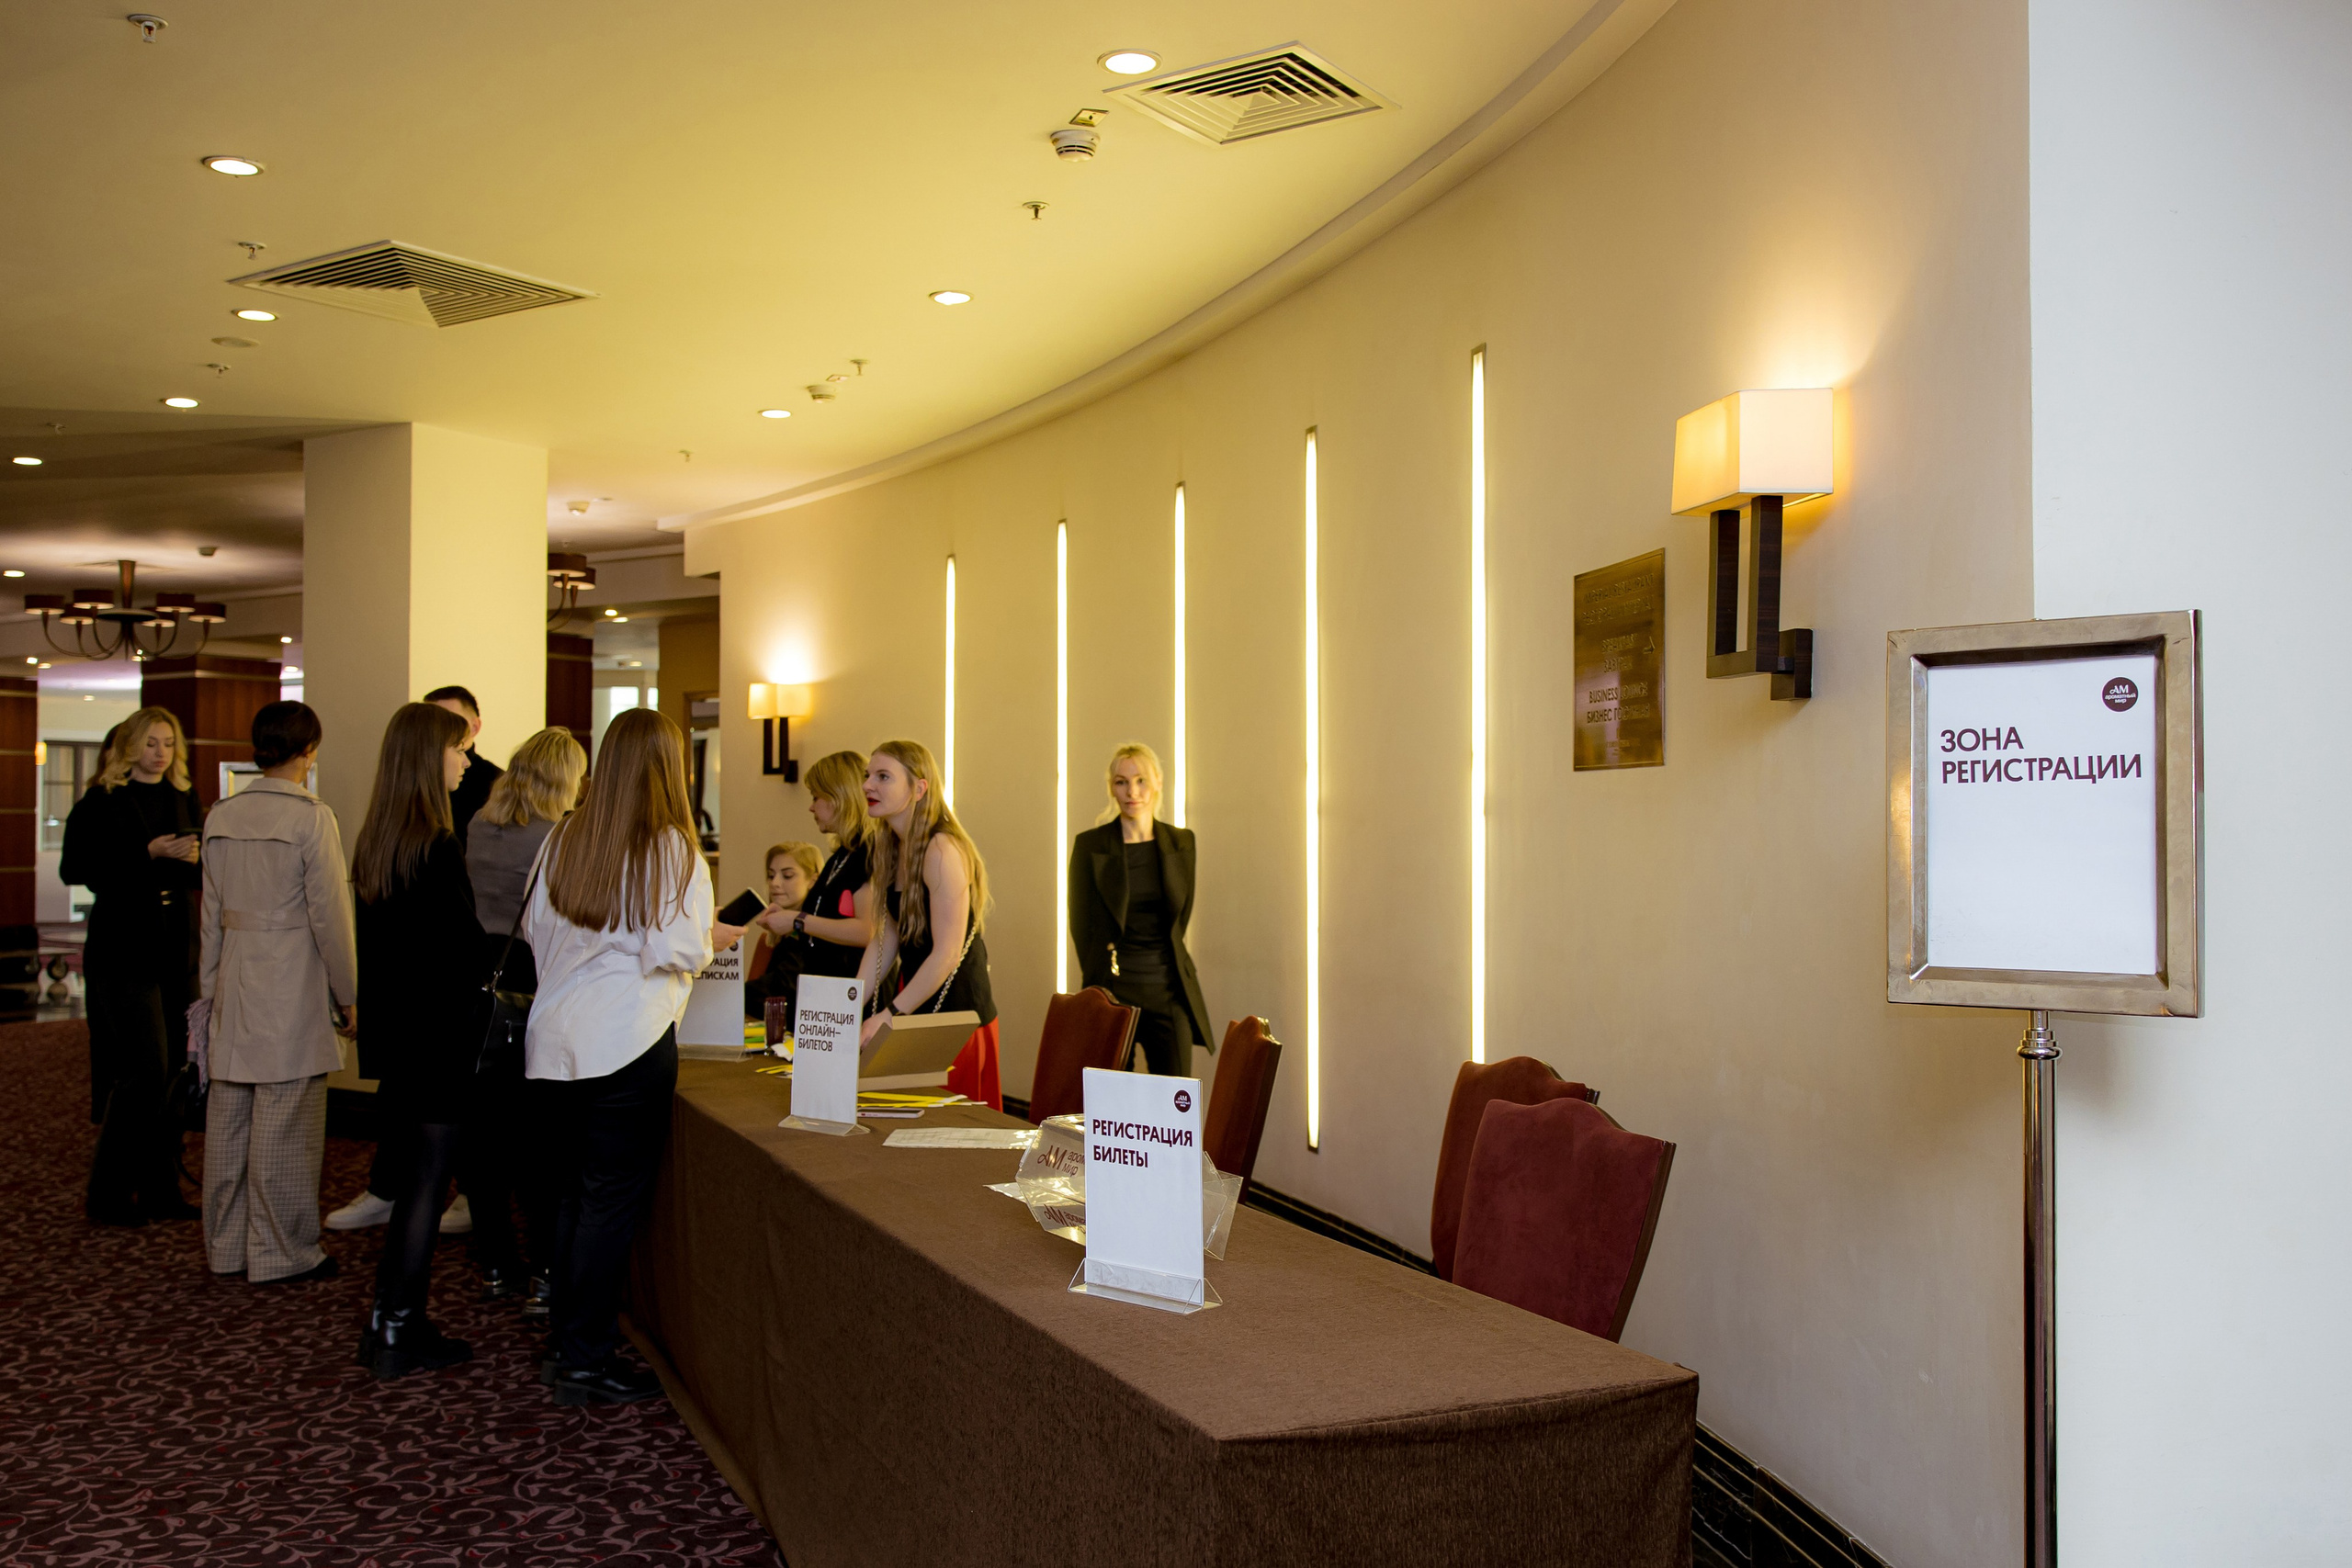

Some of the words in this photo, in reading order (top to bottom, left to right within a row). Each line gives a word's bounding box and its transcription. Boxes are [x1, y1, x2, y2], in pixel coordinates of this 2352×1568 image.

[1589, 687, 1618, 704] BUSINESS
[1587, 707, 1612, 724] БИЗНЕС
[1939, 726, 2025, 753] ЗОНА
[1940, 753, 2143, 784] РЕГИСТРАЦИИ
[799, 1010, 854, 1026] РЕГИСТРАЦИЯ
[797, 1038, 833, 1052] БИЛЕТОВ
[1091, 1118, 1193, 1147] РЕГИСТРАЦИЯ
[1092, 1145, 1148, 1168] БИЛЕТЫ
[1062, 1163, 1079, 1177] мир
